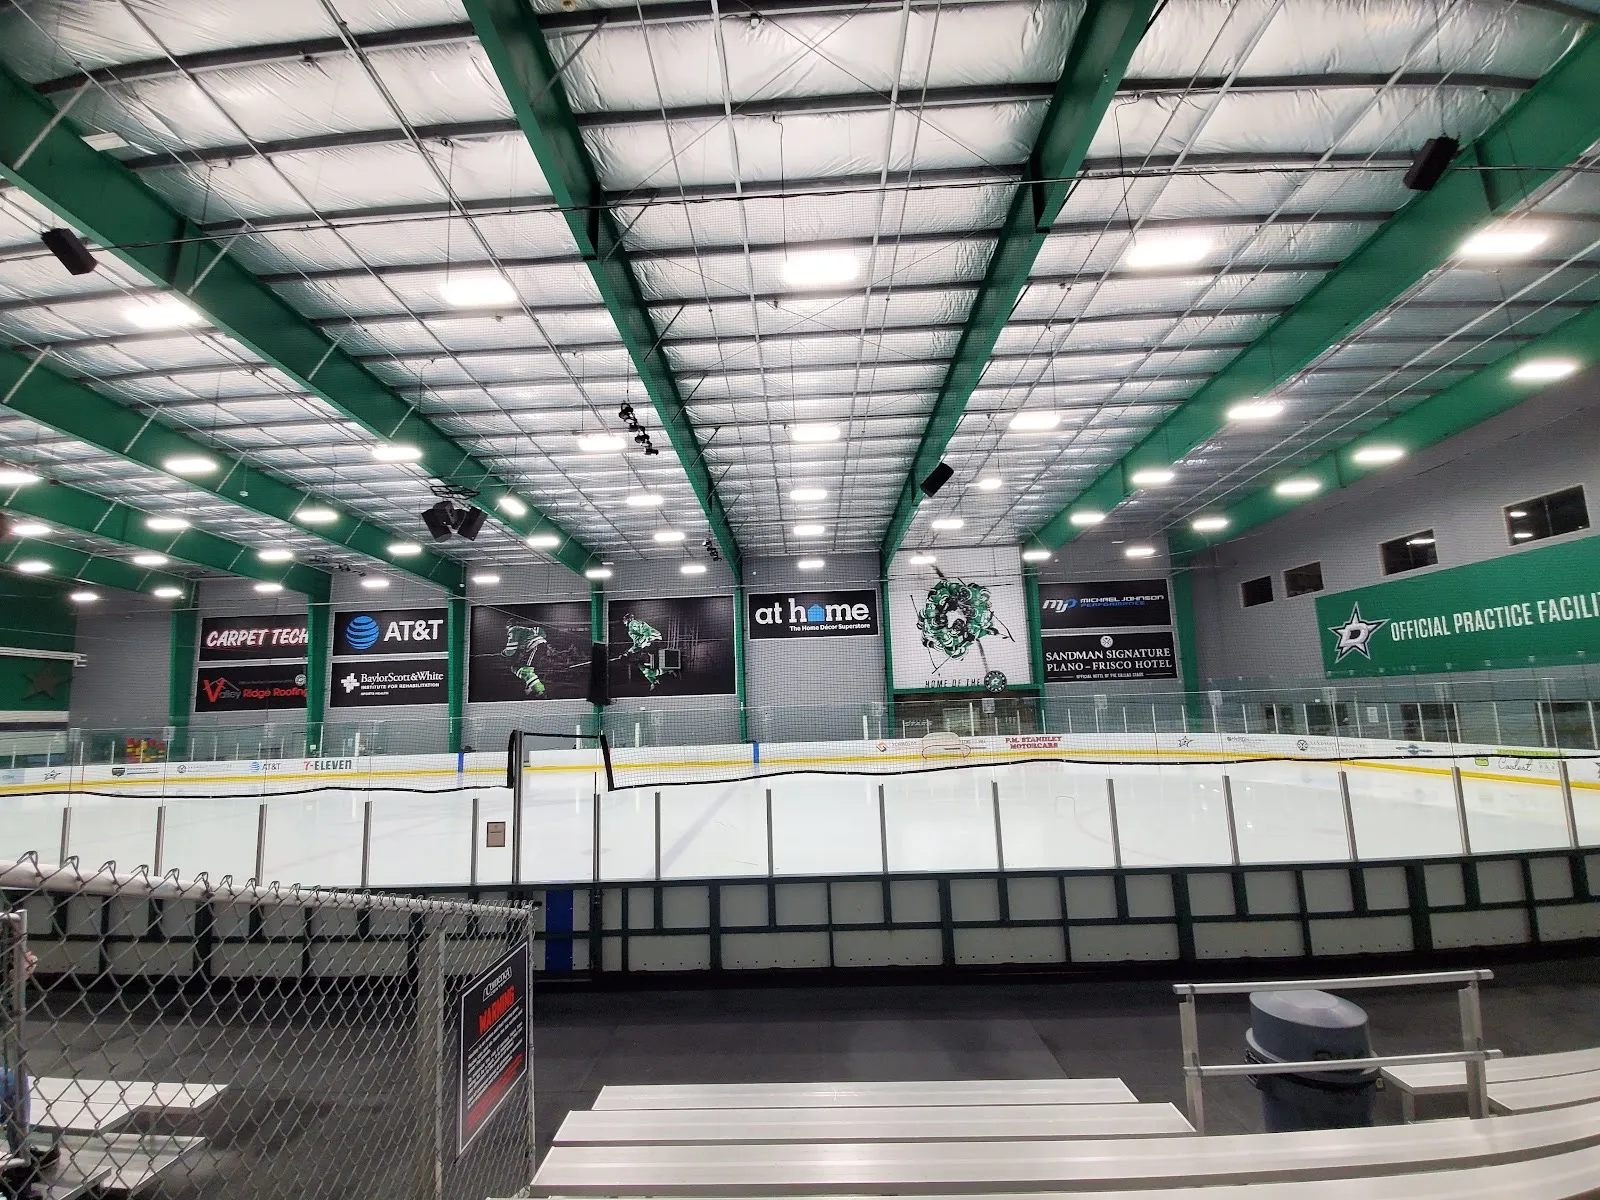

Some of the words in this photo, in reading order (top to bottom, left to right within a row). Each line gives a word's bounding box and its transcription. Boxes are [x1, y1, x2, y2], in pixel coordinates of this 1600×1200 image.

[755, 602, 782, 624] at
[1391, 615, 1451, 642] OFFICIAL
[1453, 602, 1534, 634] PRACTICE
[1536, 591, 1600, 624] FACILI
[206, 628, 269, 647] CARPET
[271, 627, 309, 645] TECH
[383, 619, 444, 642] AT&T
[1046, 650, 1103, 661] SANDMAN
[1106, 648, 1171, 659] SIGNATURE
[1047, 662, 1083, 672] PLANO
[1092, 661, 1132, 671] FRISCO
[1135, 660, 1172, 669] HOTEL
[925, 679, 947, 688] HOME
[952, 679, 961, 687] OF
[966, 678, 980, 687] THE
[243, 688, 271, 699] Ridge
[262, 762, 281, 771] AT&T
[304, 759, 352, 771] 7-ELEVEN
[479, 984, 515, 1036] WARNING
